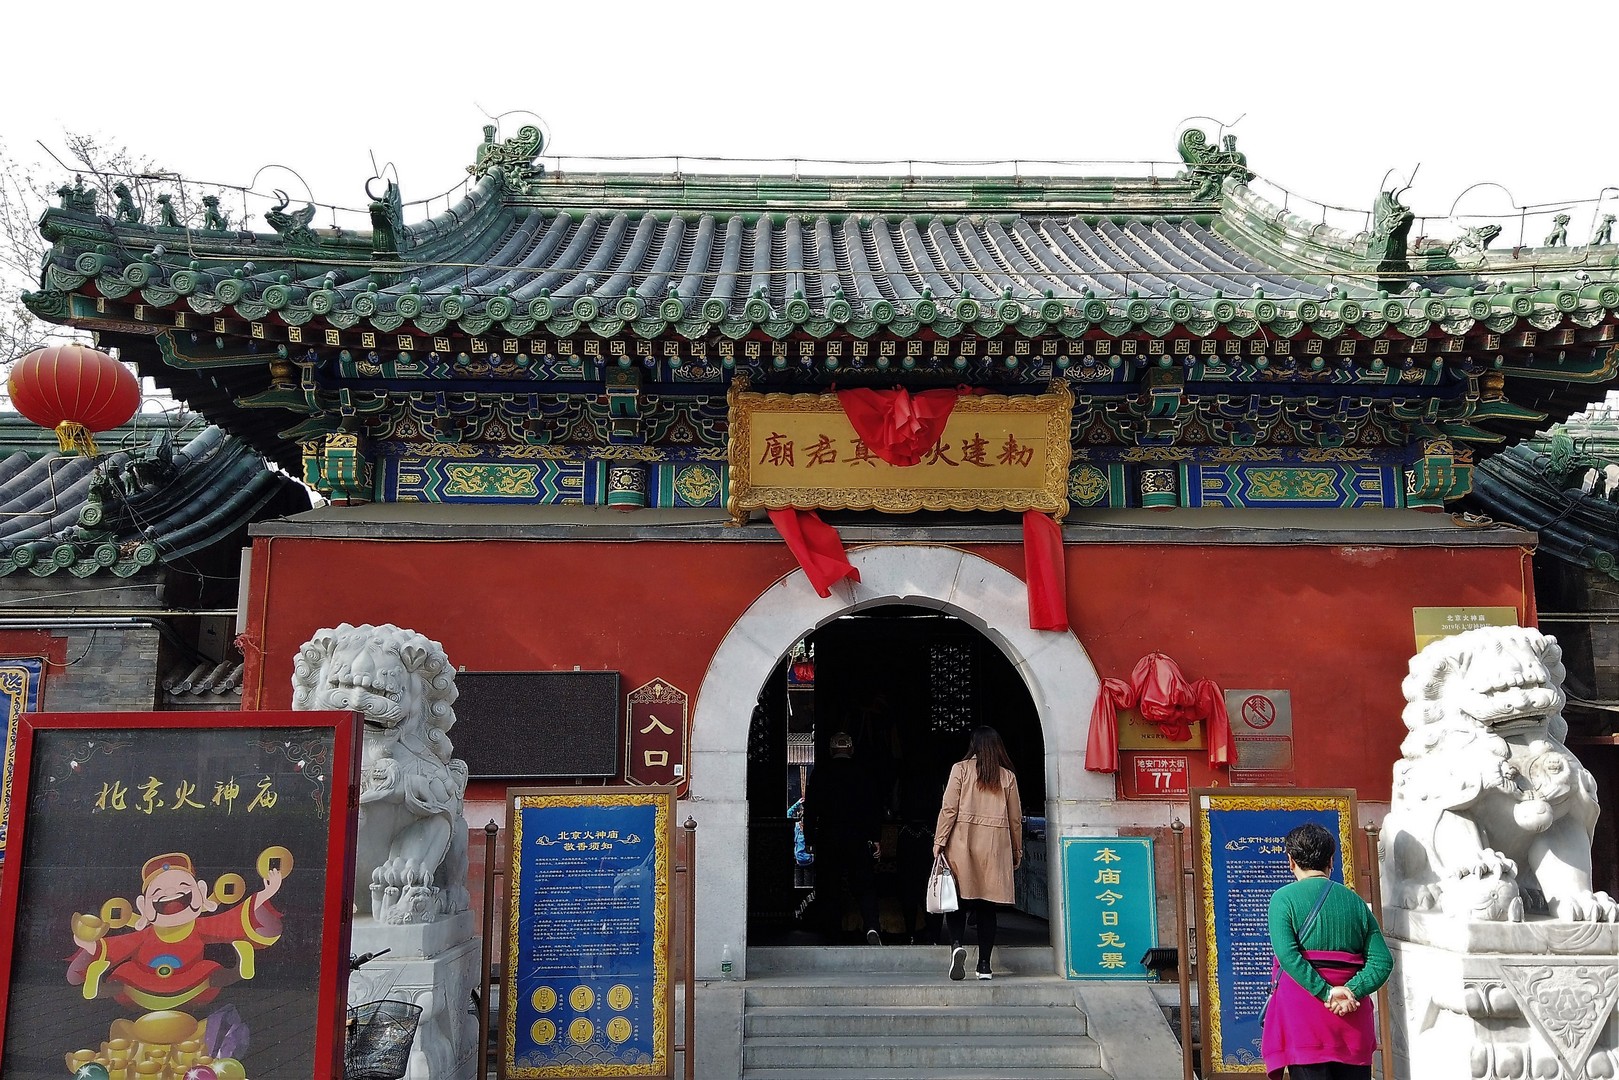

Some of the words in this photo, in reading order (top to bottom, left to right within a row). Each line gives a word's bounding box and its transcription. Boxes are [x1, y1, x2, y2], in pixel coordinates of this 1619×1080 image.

[640, 714, 674, 767] 入口
[1137, 759, 1185, 768] 地安门外大街
[1151, 772, 1172, 788] 77
[95, 775, 278, 815] 北京火神庙
[557, 830, 619, 840] 北京火神庙
[563, 841, 613, 851] 敬香须知
[1093, 847, 1126, 969] 本庙今日免票
